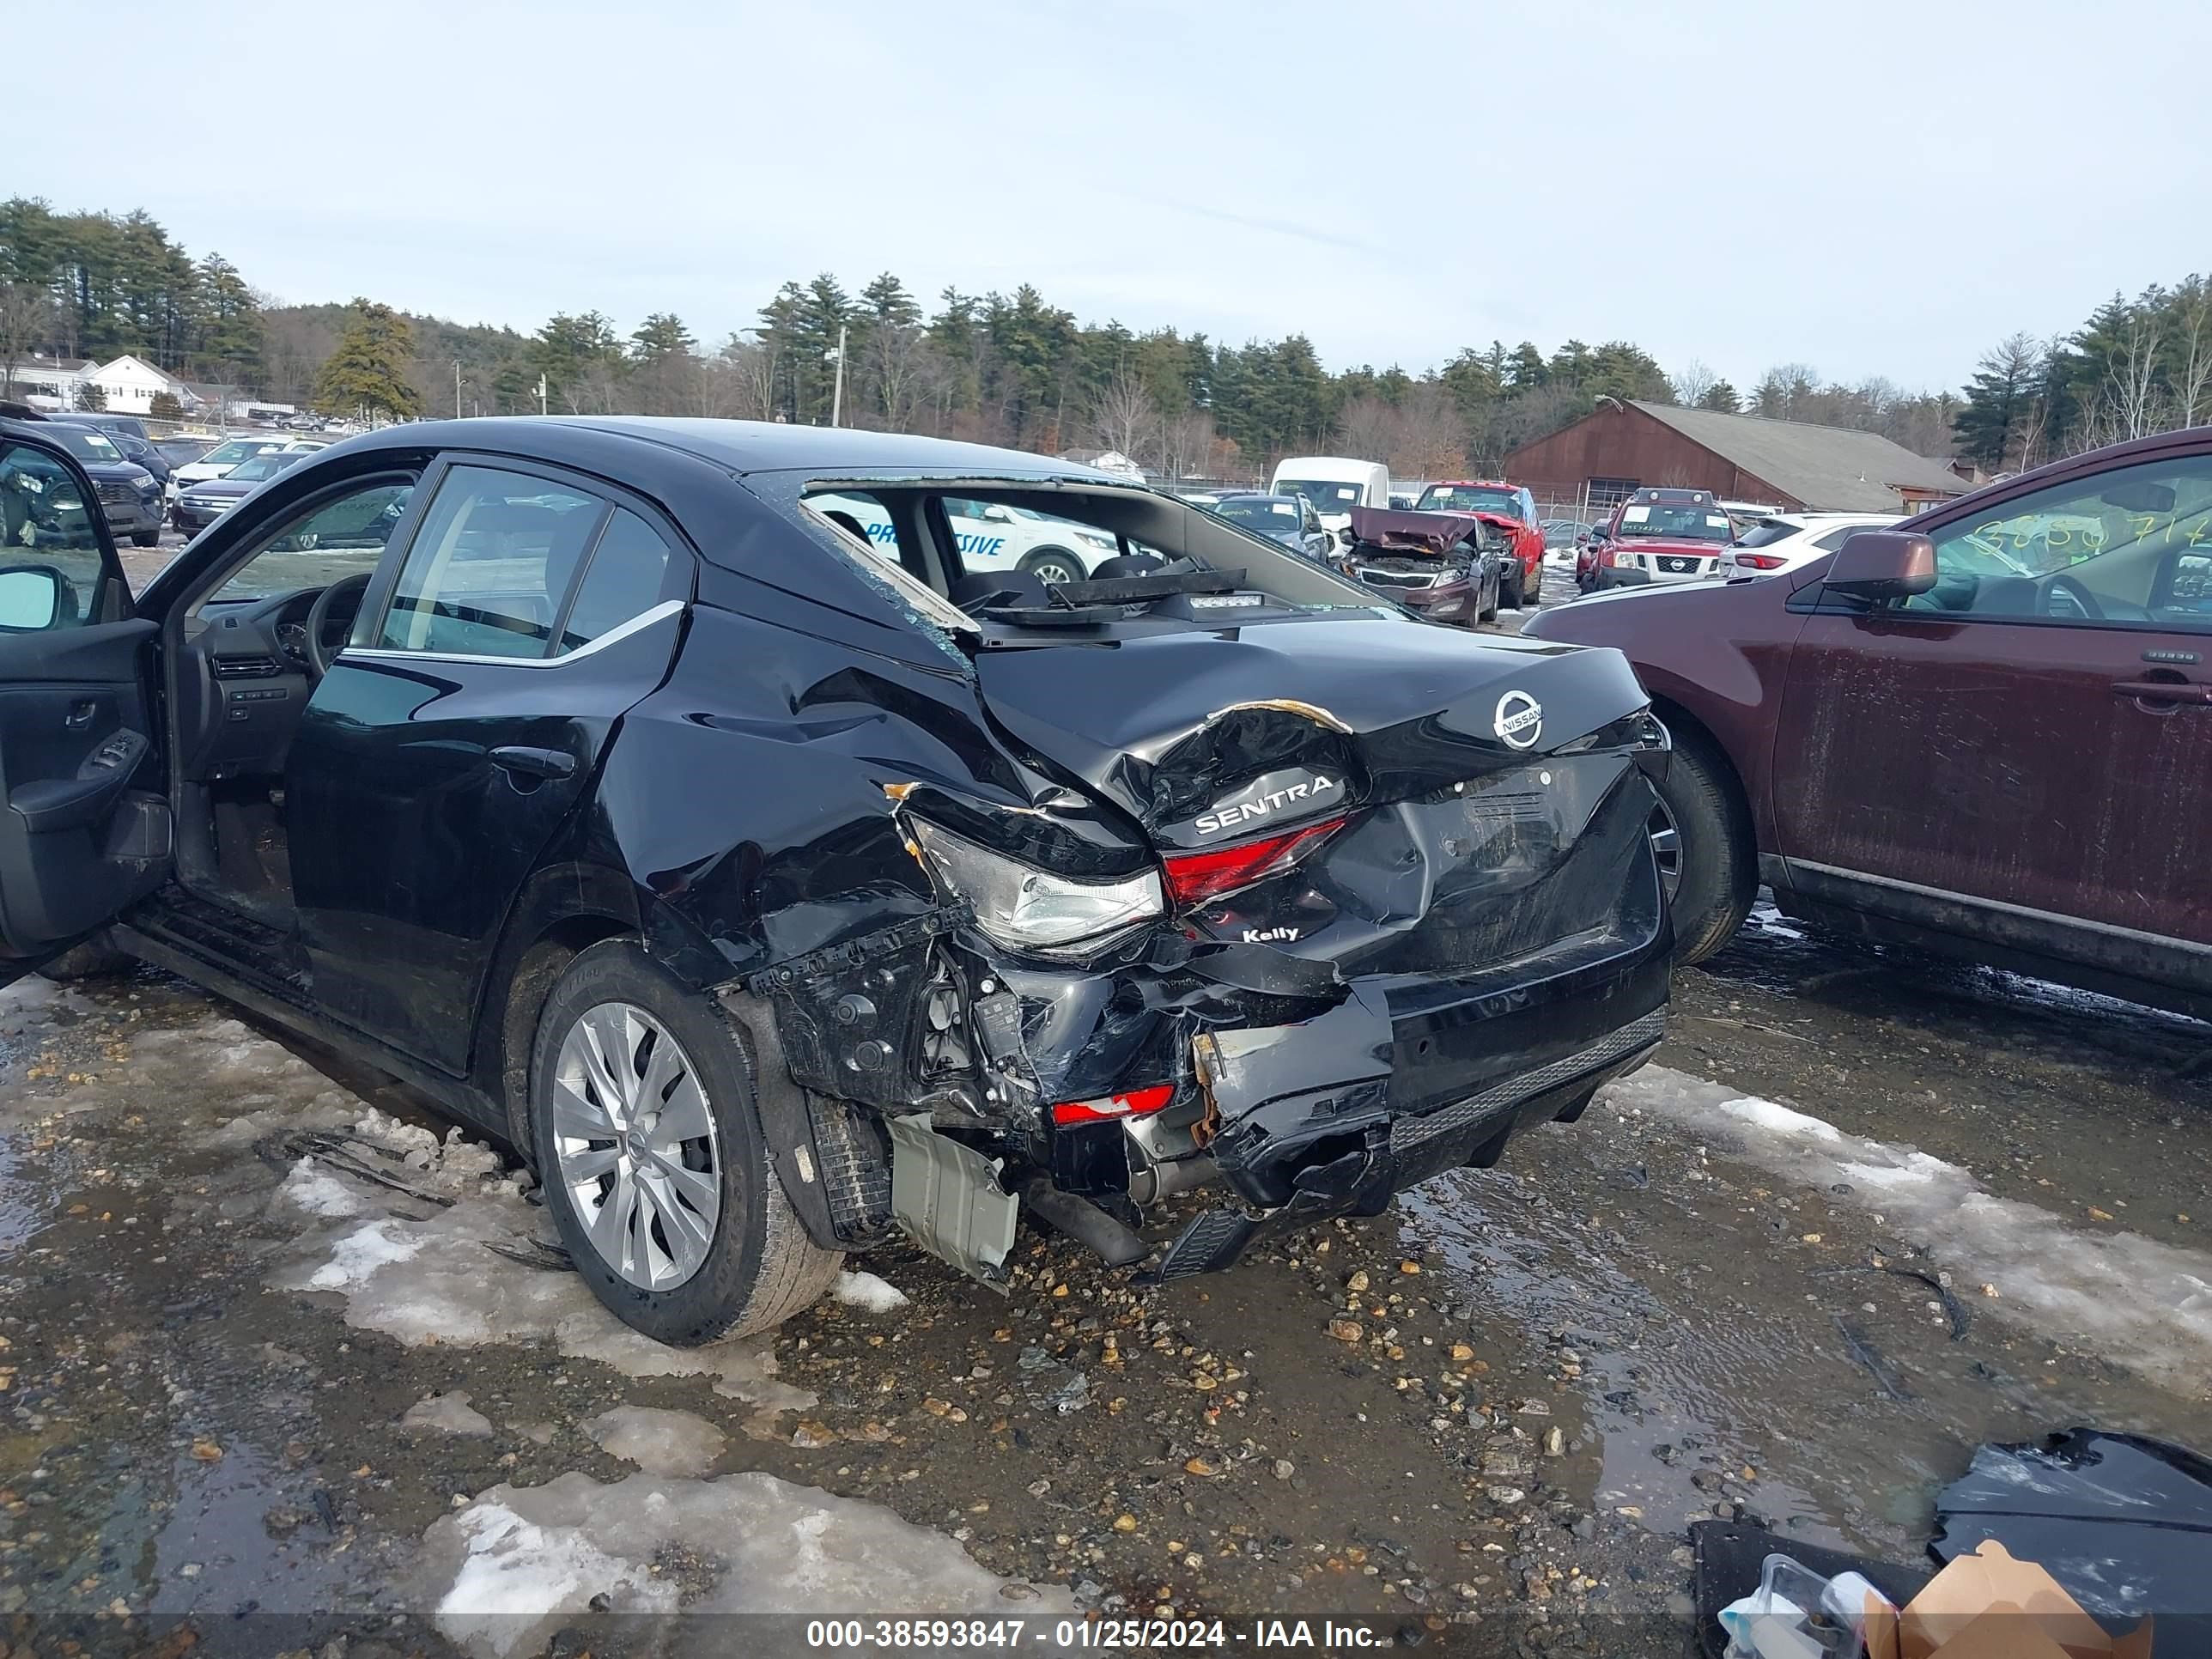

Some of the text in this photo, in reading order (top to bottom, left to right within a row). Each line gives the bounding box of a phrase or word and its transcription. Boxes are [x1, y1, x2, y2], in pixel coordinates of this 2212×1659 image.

[1503, 708, 1541, 732] NISSAN
[1194, 775, 1334, 836] SENTRA
[1242, 927, 1299, 944] Kelly
